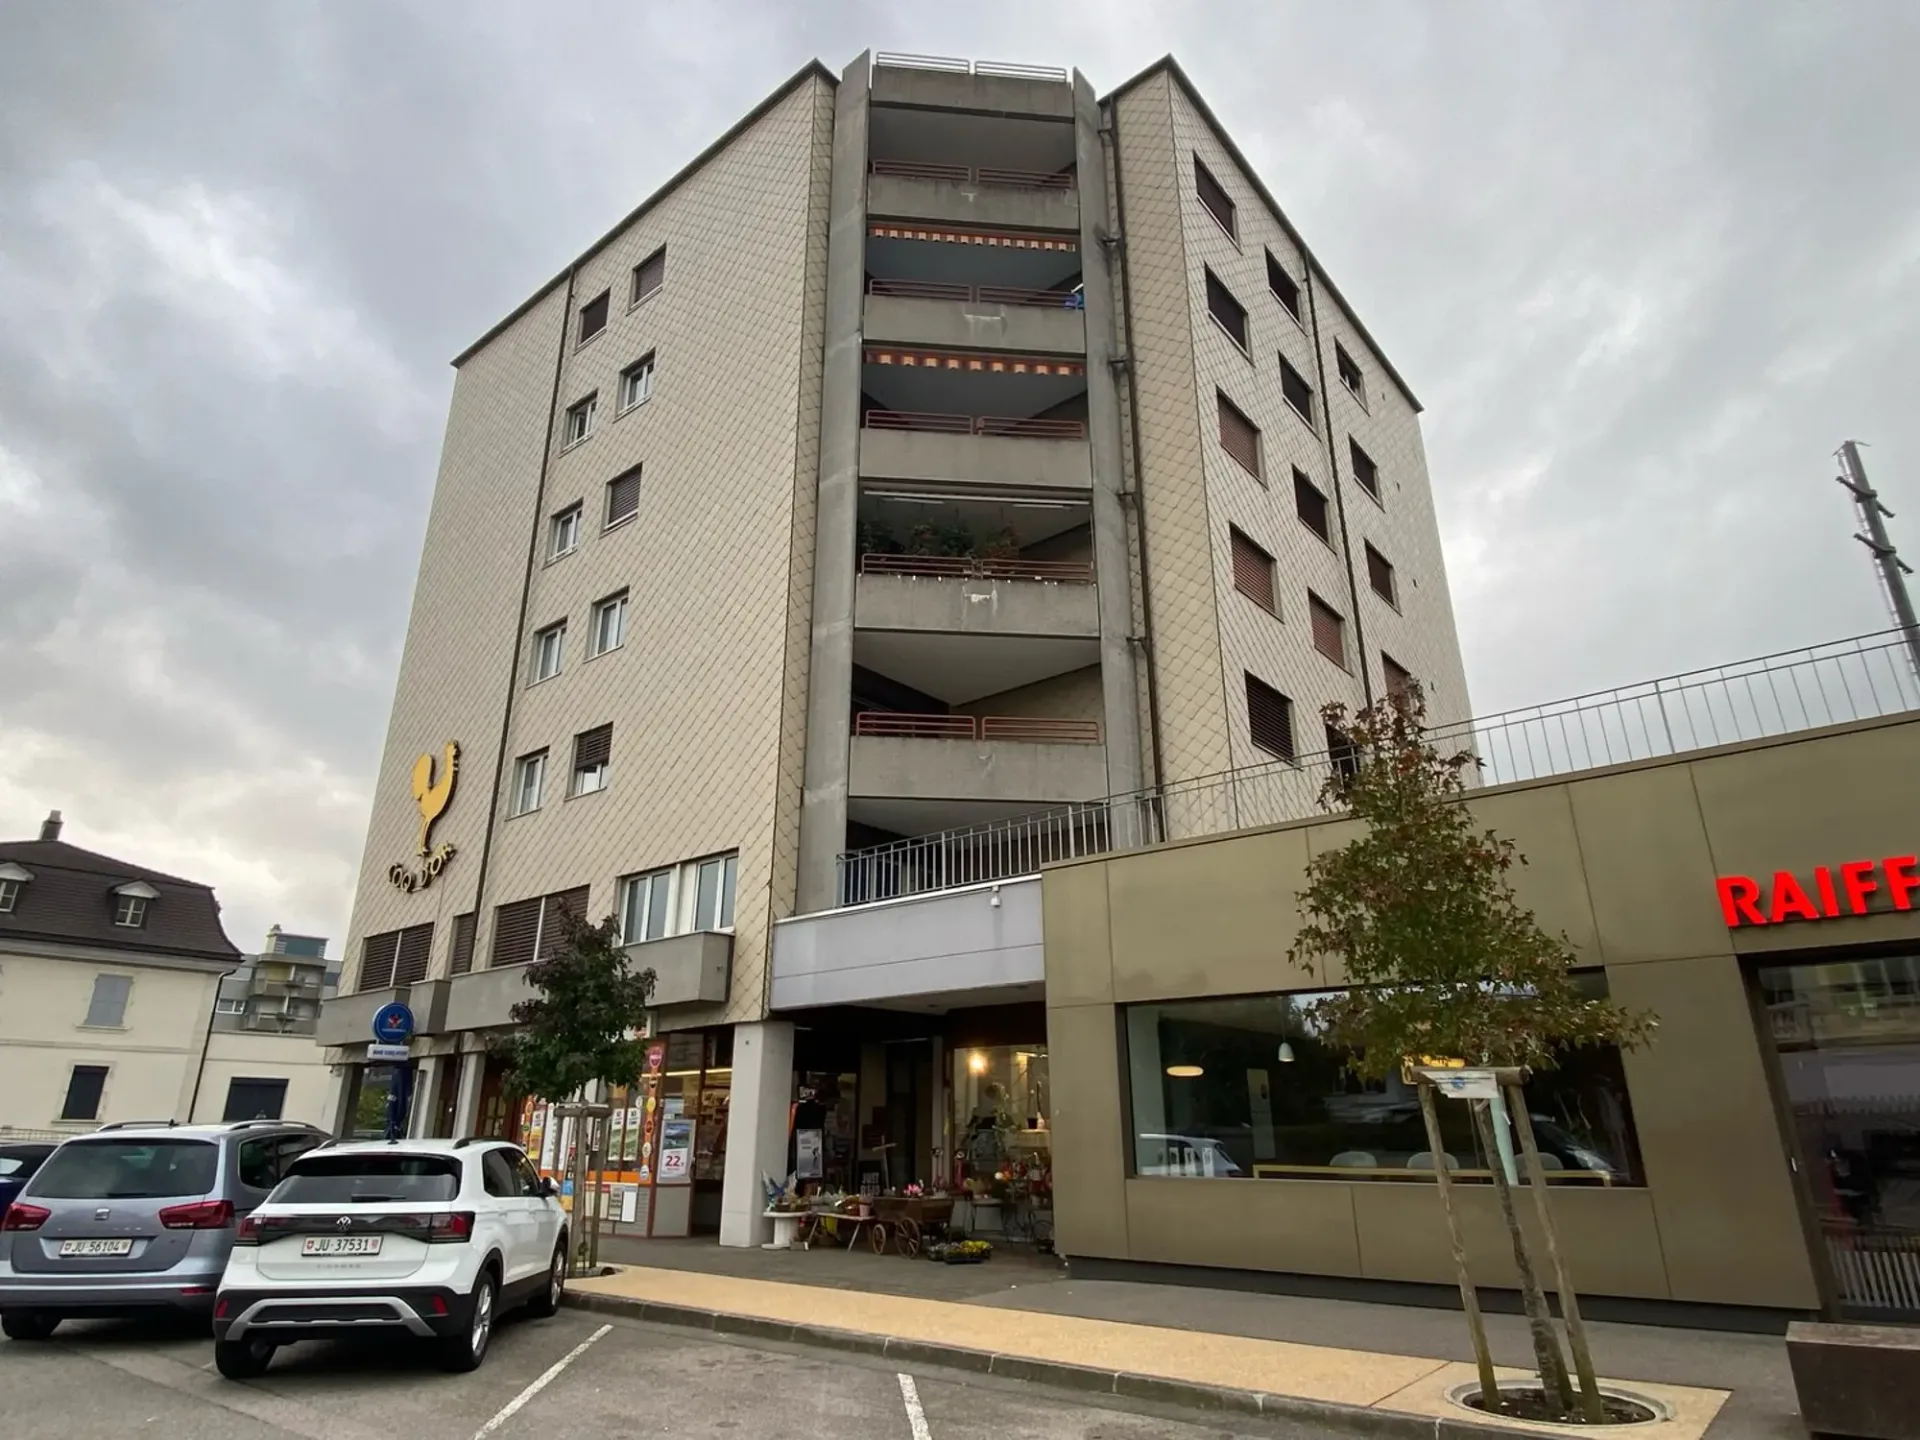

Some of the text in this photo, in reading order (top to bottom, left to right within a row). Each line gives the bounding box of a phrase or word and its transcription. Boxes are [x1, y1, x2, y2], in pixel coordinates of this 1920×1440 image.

[1716, 854, 1920, 928] RAIFF
[89, 1241, 120, 1252] 56104
[335, 1239, 369, 1251] 37531
